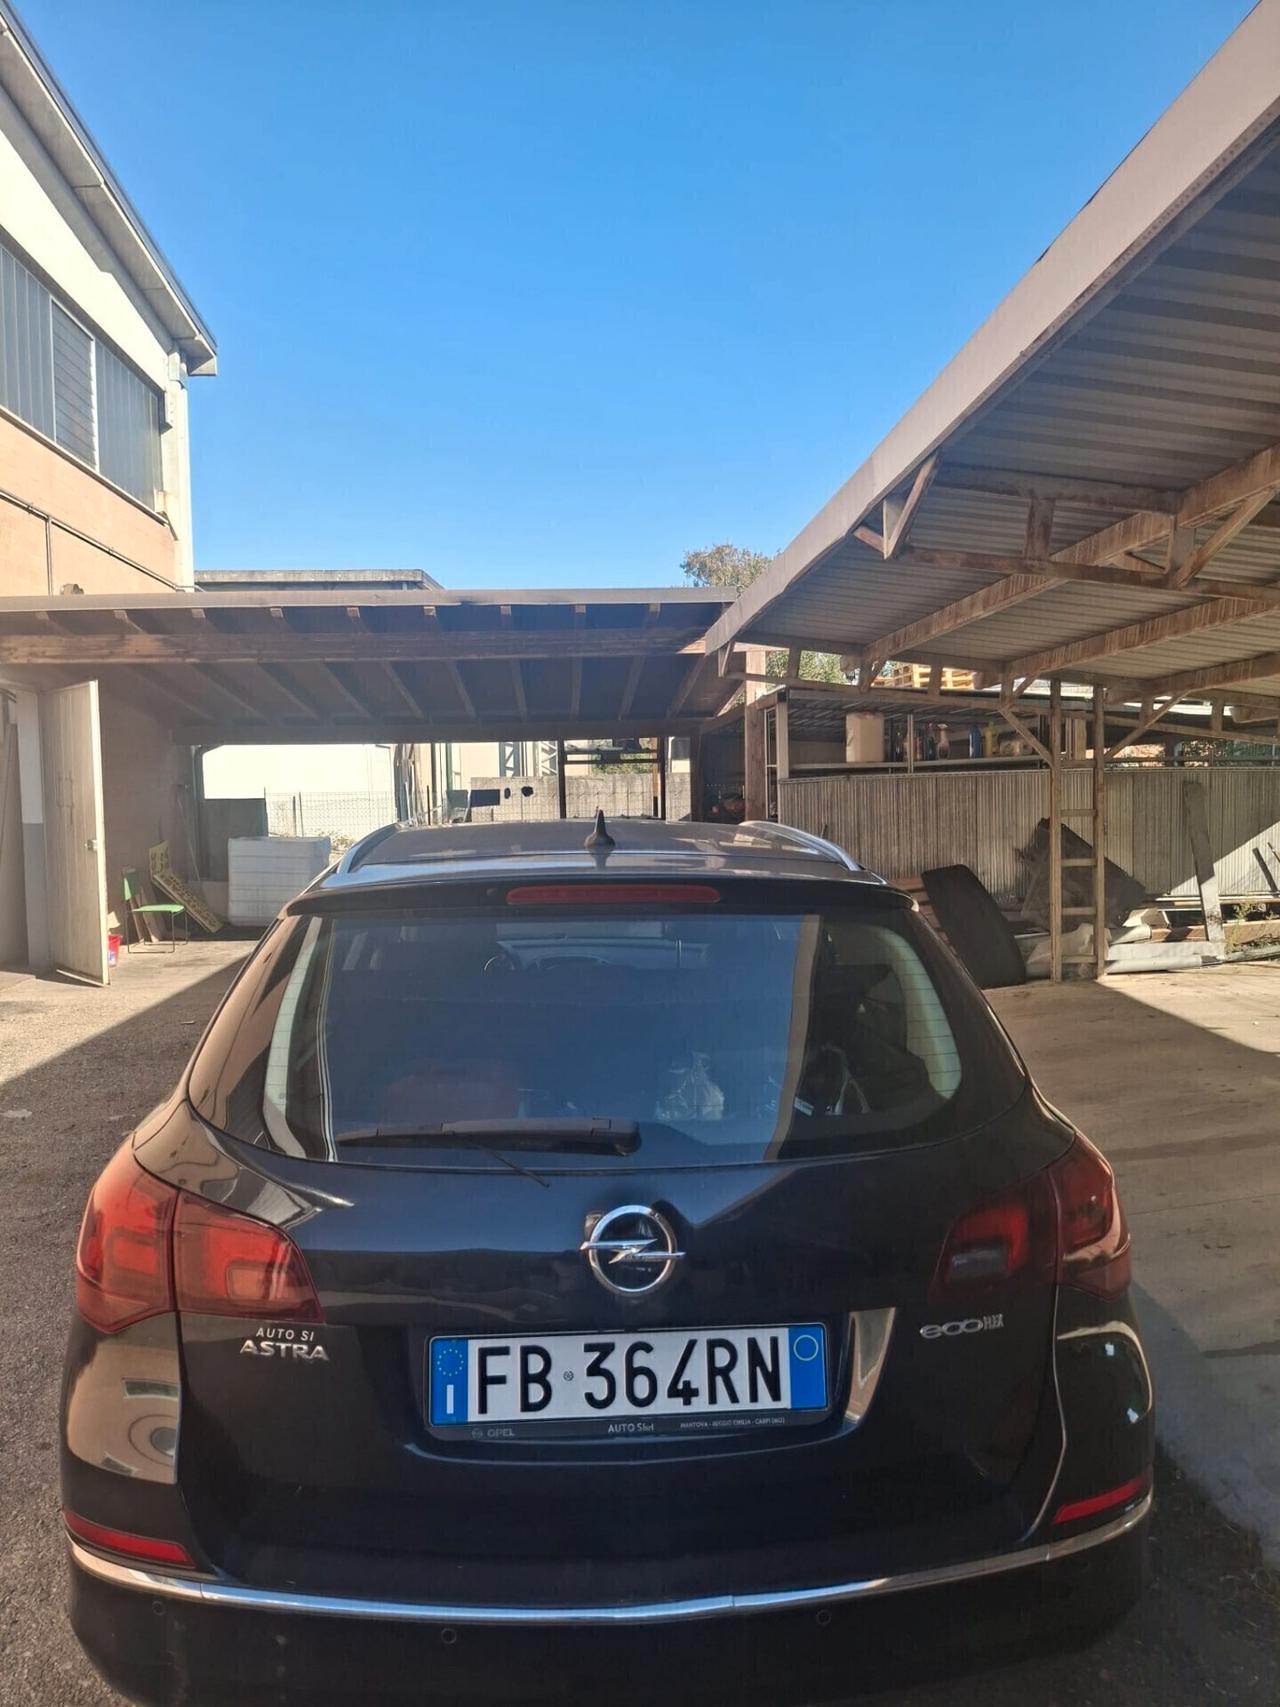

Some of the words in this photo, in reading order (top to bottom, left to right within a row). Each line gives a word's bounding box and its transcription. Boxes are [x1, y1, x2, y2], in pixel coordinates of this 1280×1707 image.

[256, 1327, 294, 1340] AUTO
[300, 1330, 314, 1342] SI
[240, 1339, 330, 1361] ASTRA
[478, 1344, 552, 1415] FB
[583, 1335, 782, 1410] 364RN
[487, 1428, 515, 1437] OPEL
[608, 1423, 636, 1433] AUTO
